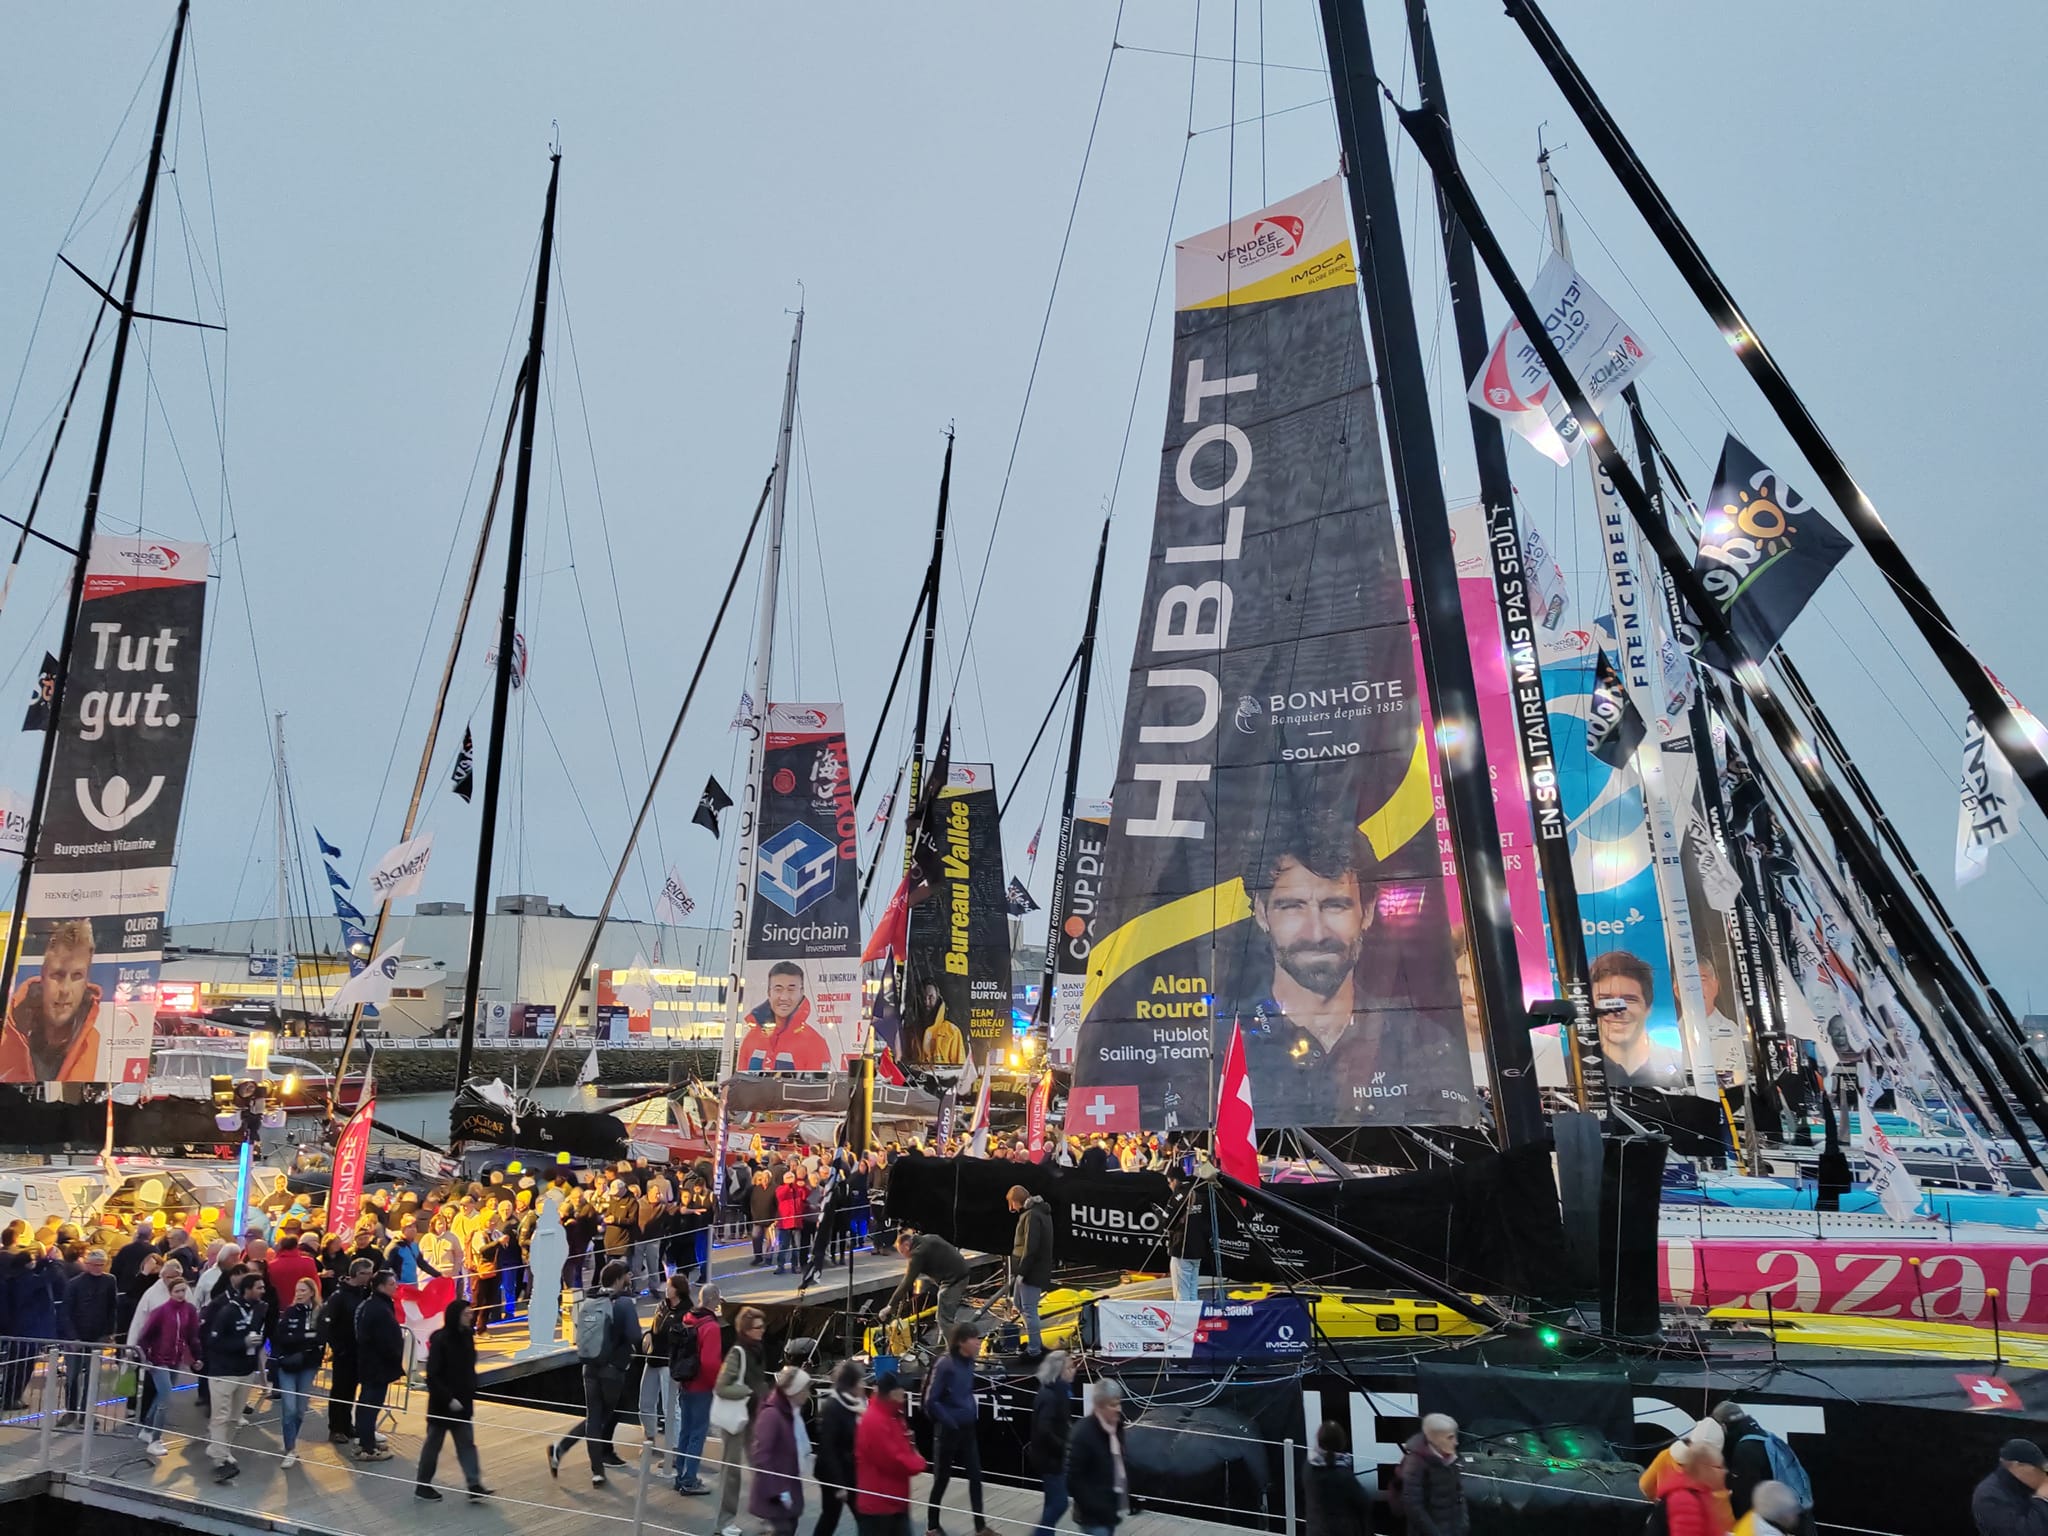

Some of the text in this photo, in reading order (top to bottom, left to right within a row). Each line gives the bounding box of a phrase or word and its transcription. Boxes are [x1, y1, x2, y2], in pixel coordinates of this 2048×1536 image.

[1216, 231, 1278, 262] VENDÉE
[1237, 238, 1286, 265] GLOBE
[1290, 252, 1346, 284] IMOCA
[1494, 517, 1519, 575] SEUL
[1124, 358, 1258, 839] HUBLOT
[1503, 580, 1528, 628] PAS
[90, 622, 180, 673] Tut
[1511, 628, 1536, 683] MAIS
[79, 684, 181, 741] gut.
[1271, 700, 1404, 726] Banquiers depuis 1815
[1281, 742, 1361, 761] SOLANO
[1523, 686, 1557, 802] SOLITAIRE
[1543, 817, 1563, 840] EN
[53, 837, 156, 857] Burgerstein Vitamine
[941, 801, 970, 879] Vallée
[1051, 873, 1064, 926] commence
[1058, 816, 1071, 872] aujourd'hui
[125, 917, 158, 932] OLIVER
[762, 922, 849, 945] Singchain
[945, 883, 970, 976] Bureau
[122, 934, 147, 948] HEER
[119, 967, 134, 981] Tut
[971, 981, 998, 990] LOUIS
[971, 991, 1007, 1000] BURTON
[1152, 975, 1207, 995] Alan
[817, 1004, 835, 1013] TEAM
[971, 1009, 994, 1017] TEAM
[970, 1018, 1005, 1028] BUREAU
[1153, 1028, 1209, 1043] Hublot
[1100, 1045, 1209, 1064] Sailing Team
[1352, 1084, 1409, 1099] HUBLOT
[1071, 1203, 1161, 1232] HUBLO
[1071, 1229, 1129, 1245] SAILING
[1204, 1306, 1223, 1317] Alan
[1265, 1341, 1309, 1349] IMOCA
